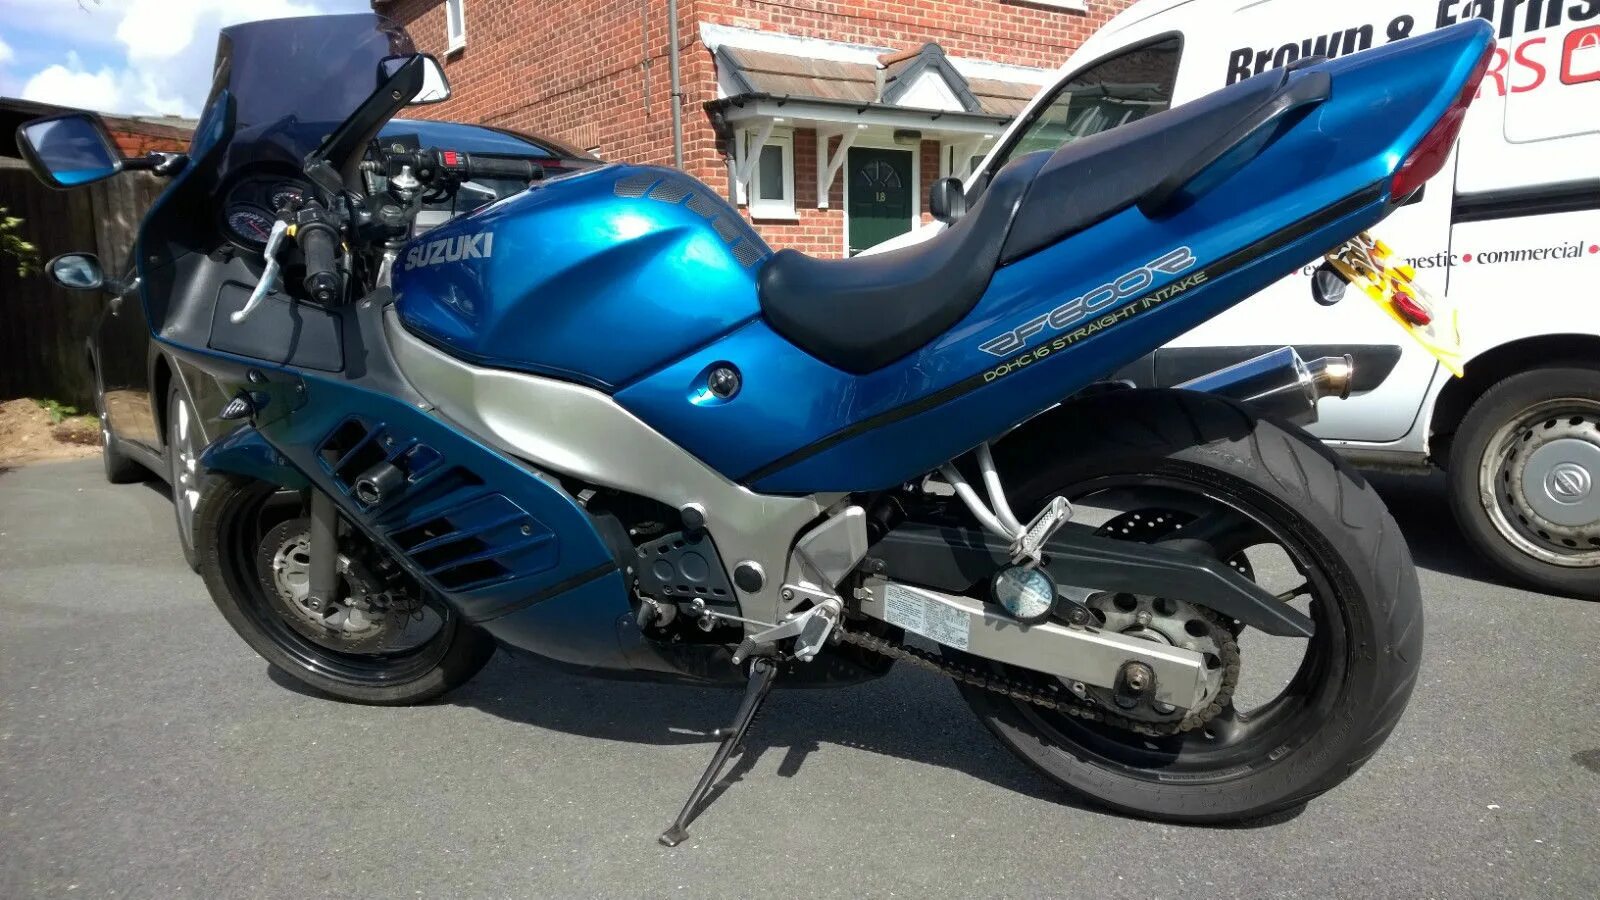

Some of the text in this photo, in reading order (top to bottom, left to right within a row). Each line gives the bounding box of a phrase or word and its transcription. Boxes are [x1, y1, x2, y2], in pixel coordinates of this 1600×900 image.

[1226, 24, 1373, 86] Brown
[1386, 14, 1415, 43] &
[404, 232, 494, 271] SUZUKI
[1477, 240, 1584, 264] commercial
[978, 246, 1196, 357] RF600R
[983, 271, 1208, 383] DOHC 16 STRAIGHT INTAKE
